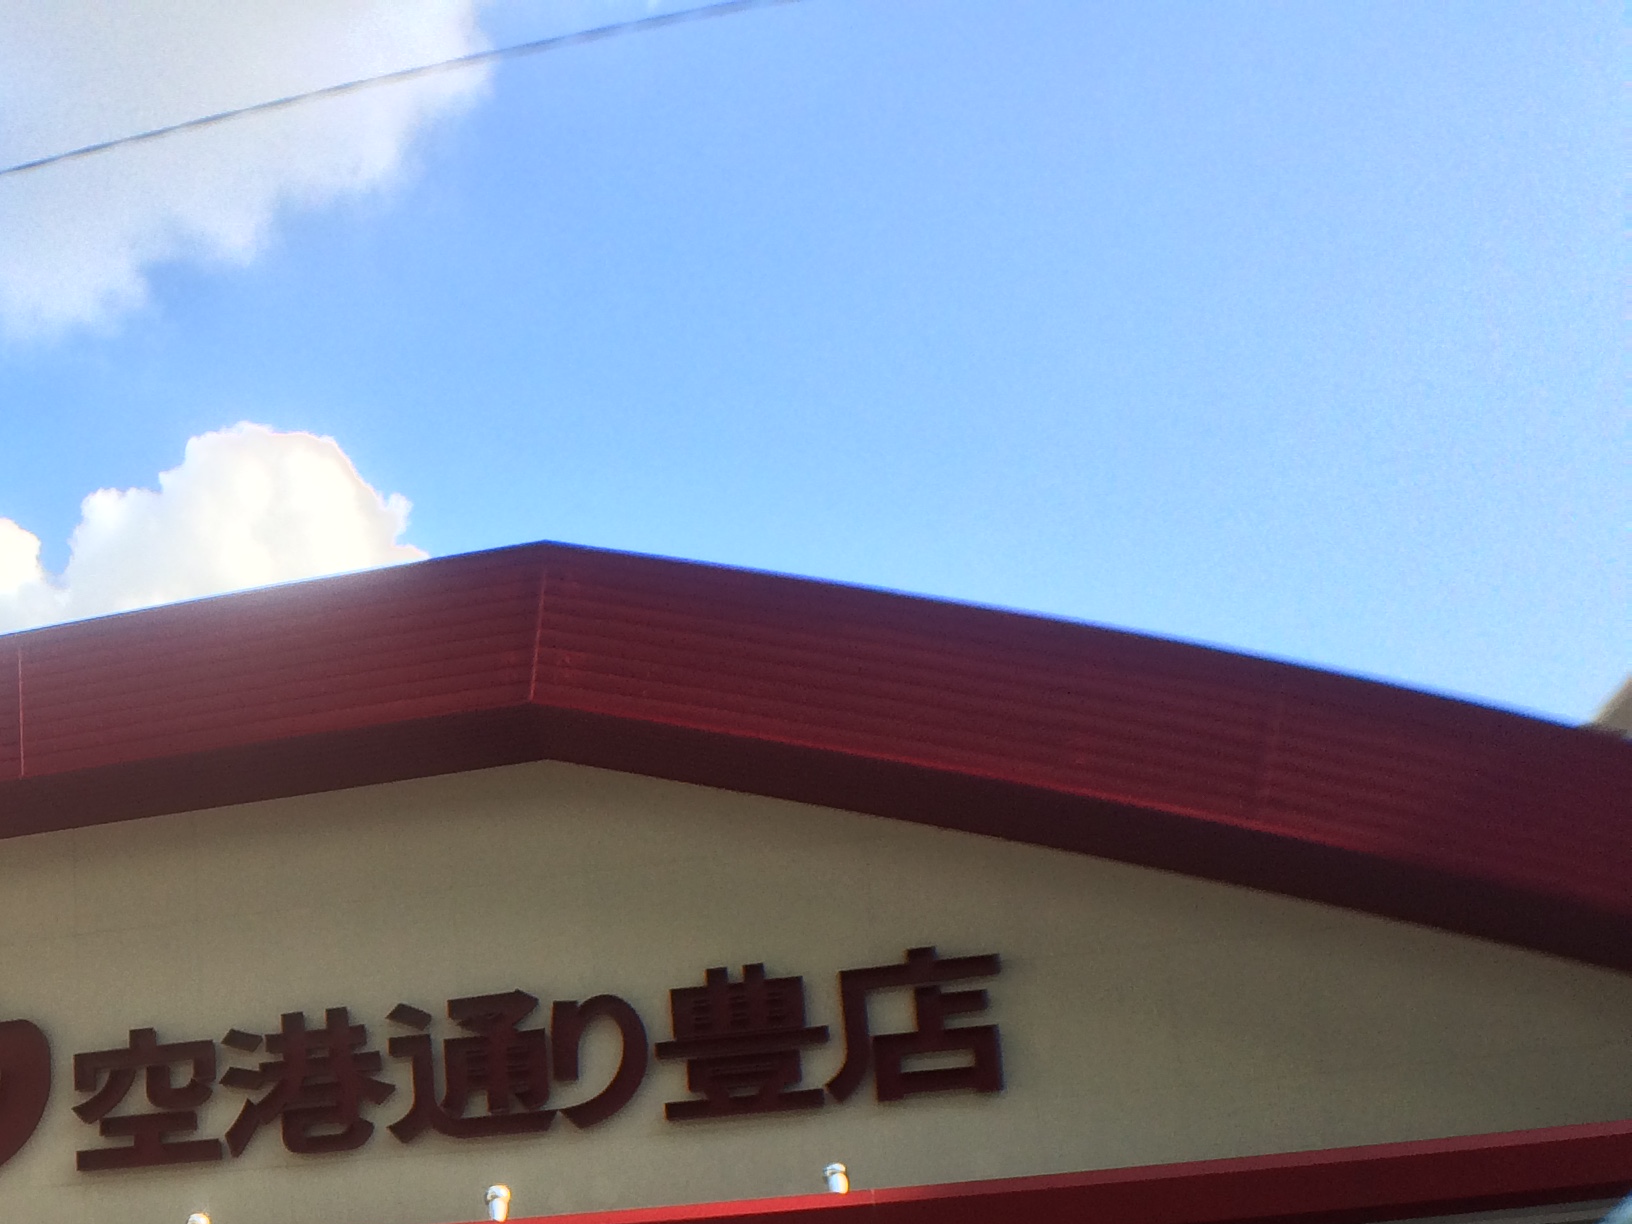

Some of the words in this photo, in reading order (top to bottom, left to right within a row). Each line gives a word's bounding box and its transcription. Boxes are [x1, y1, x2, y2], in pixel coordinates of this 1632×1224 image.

[72, 945, 1003, 1173] 空港通り豊店
